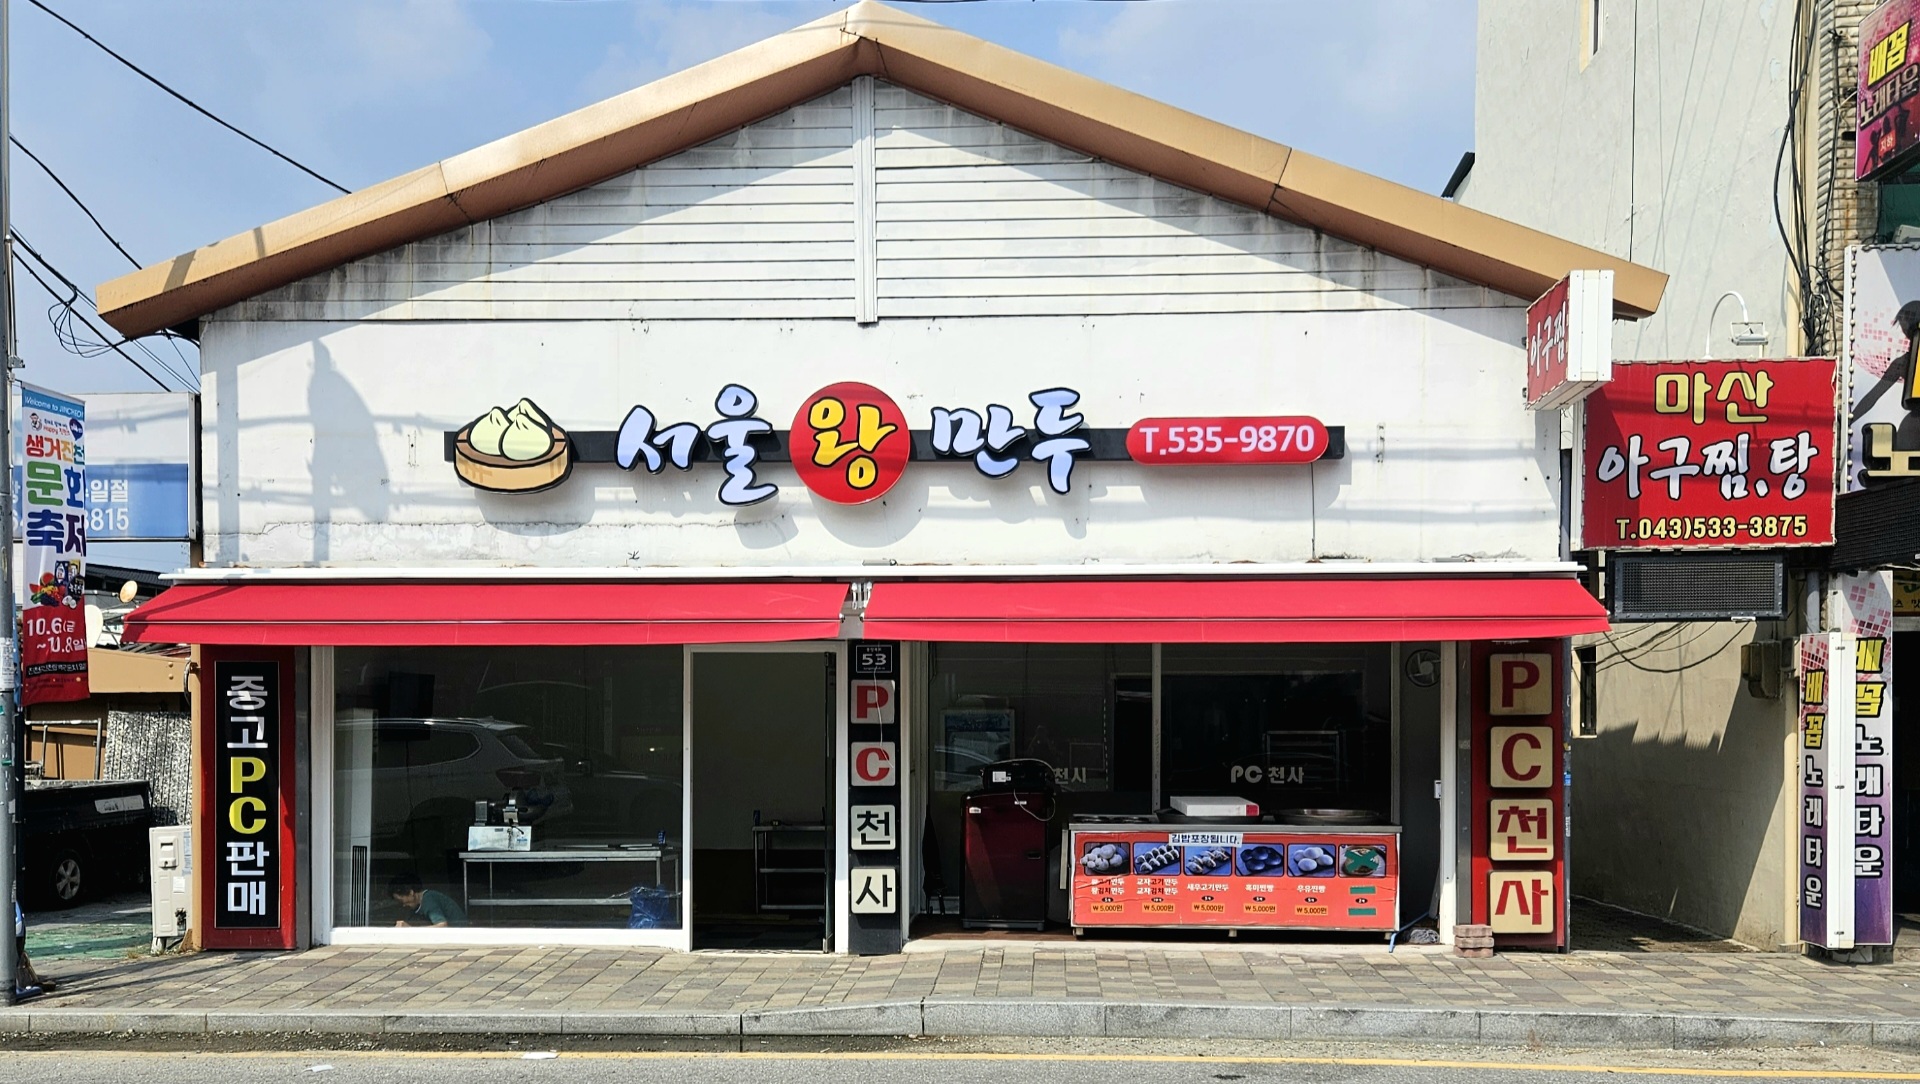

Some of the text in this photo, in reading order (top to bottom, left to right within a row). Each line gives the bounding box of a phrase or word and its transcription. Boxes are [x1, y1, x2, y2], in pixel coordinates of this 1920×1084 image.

[1868, 20, 1911, 88] 배꼽
[1860, 63, 1920, 131] 노래타운
[1530, 300, 1566, 378] 아구찜
[24, 395, 51, 410] Welcome
[51, 403, 58, 412] to
[1655, 371, 1774, 425] 마산
[26, 434, 85, 465] 생거진천
[616, 383, 779, 507] 서울
[930, 386, 1092, 494] 만두
[1139, 425, 1316, 457] T.535-9870
[85, 480, 128, 503] 일절
[1616, 515, 1807, 540] T.043)533-3875
[861, 653, 887, 666] 53
[1230, 765, 1304, 784] PC 천사
